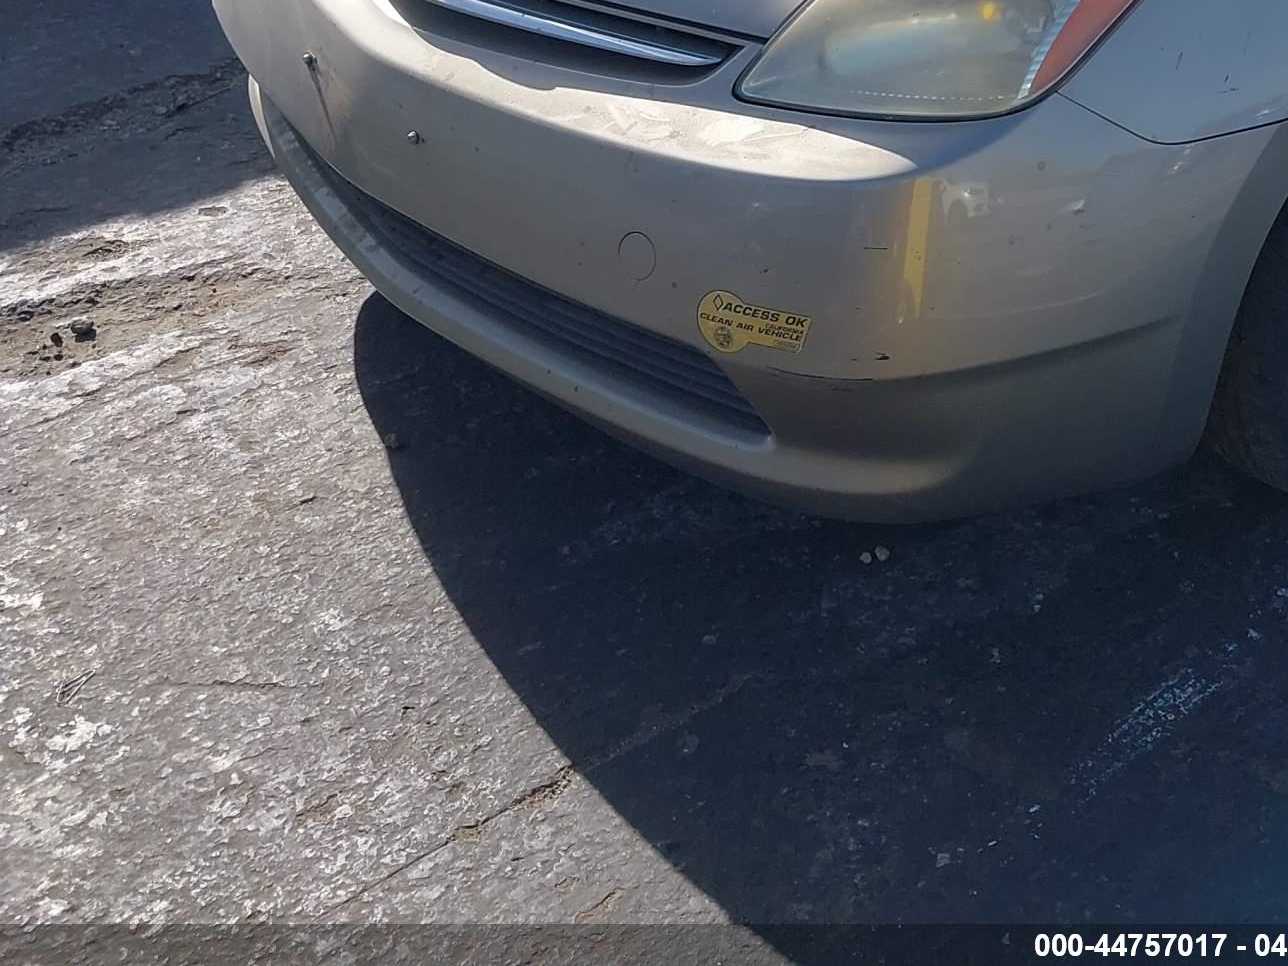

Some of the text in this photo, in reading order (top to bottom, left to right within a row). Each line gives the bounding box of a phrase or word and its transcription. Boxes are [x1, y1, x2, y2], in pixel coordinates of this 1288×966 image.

[700, 312, 802, 342] CLEAN AIR VEHICLE
[723, 302, 808, 328] ACCESS OK
